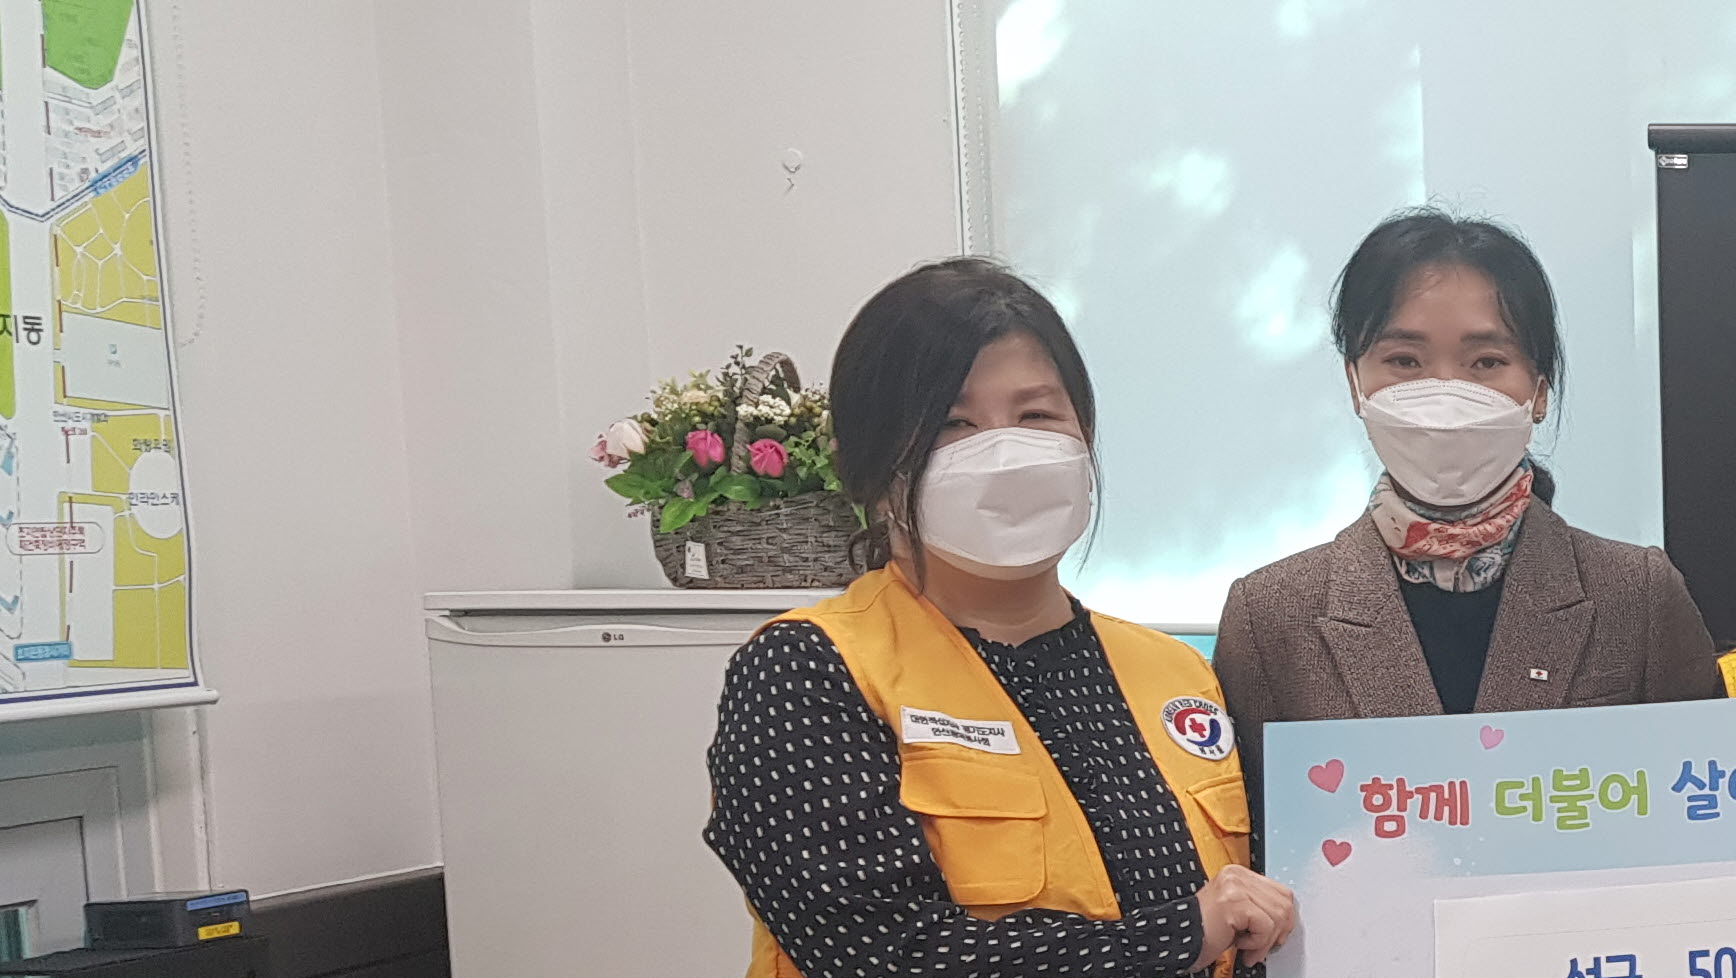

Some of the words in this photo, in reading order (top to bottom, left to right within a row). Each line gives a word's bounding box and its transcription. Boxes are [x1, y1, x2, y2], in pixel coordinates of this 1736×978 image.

[613, 633, 625, 641] LG
[1359, 775, 1471, 840] 함께
[1493, 766, 1649, 832] 더불어
